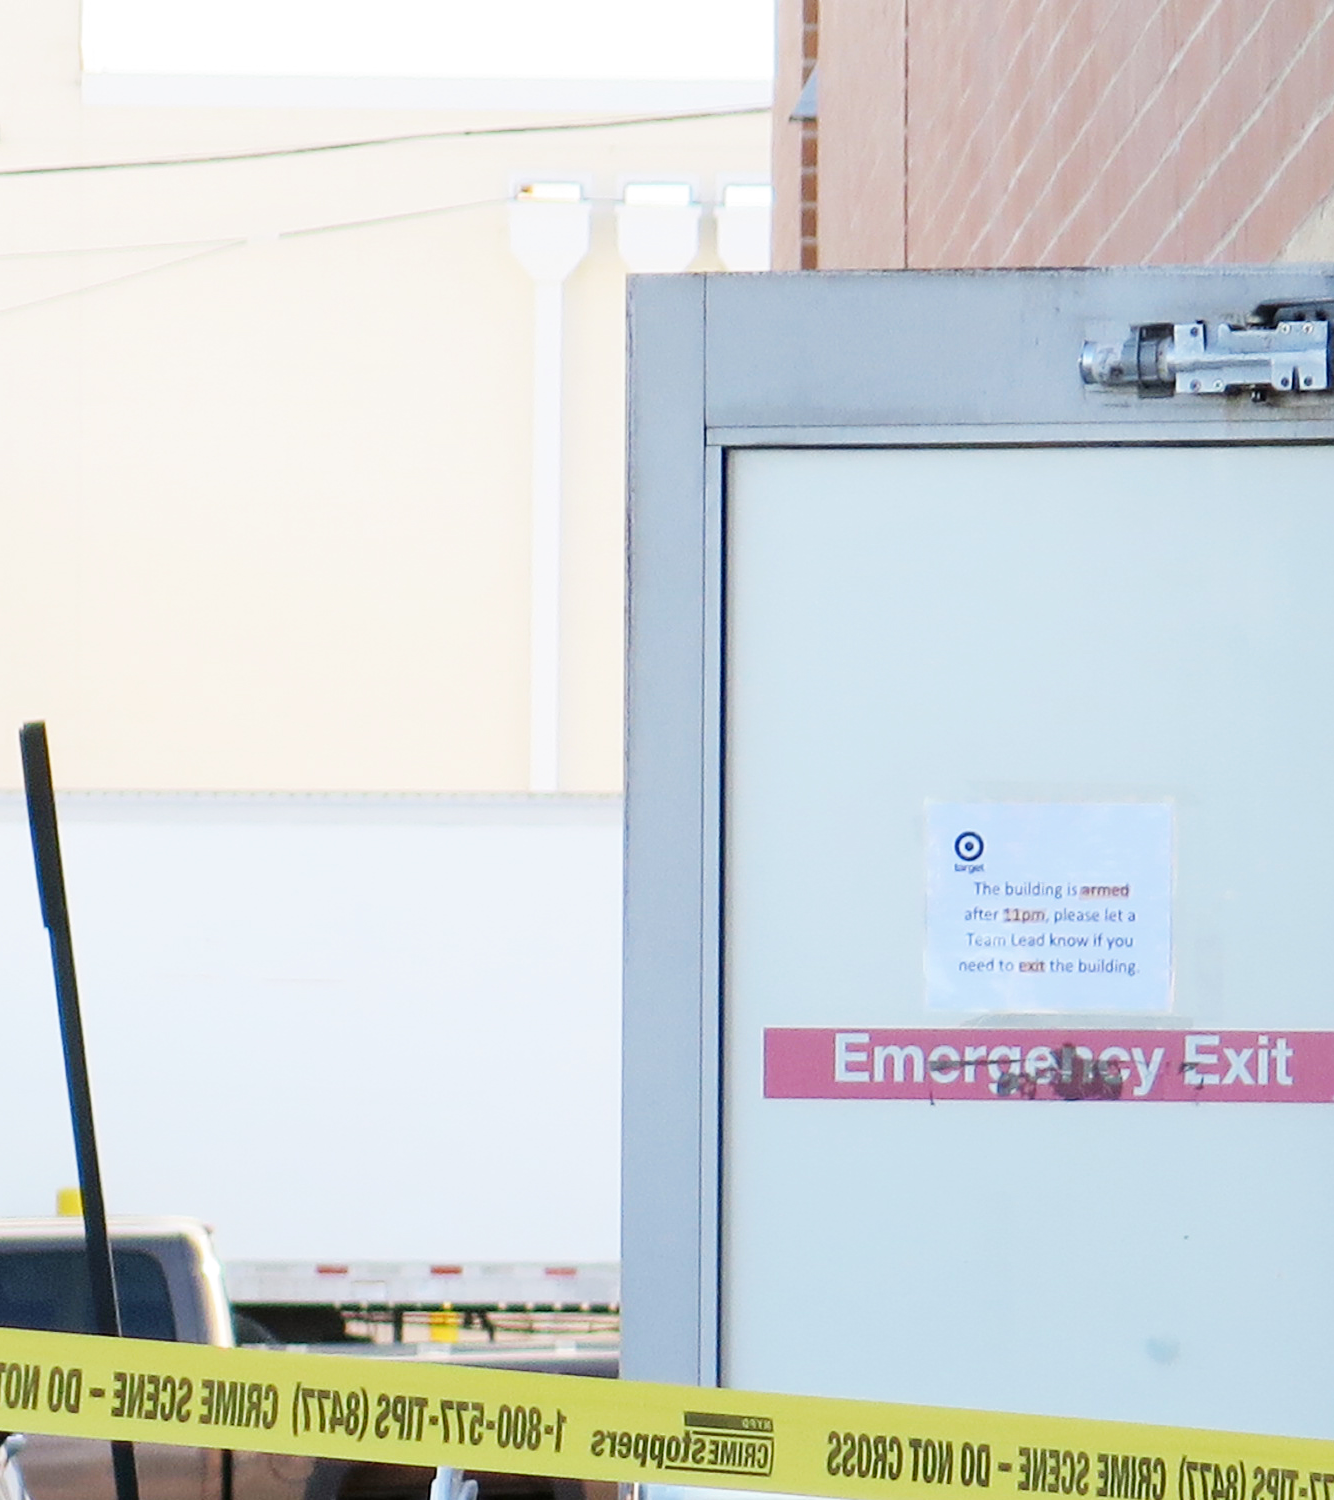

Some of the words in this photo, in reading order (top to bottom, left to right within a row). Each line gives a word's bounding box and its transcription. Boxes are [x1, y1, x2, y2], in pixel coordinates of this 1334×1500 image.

[974, 882, 1000, 896] The
[1005, 882, 1062, 899] building
[1068, 883, 1077, 896] is
[1081, 884, 1130, 897] armed
[965, 909, 998, 921] after
[1003, 908, 1050, 923] 11pm,
[1054, 908, 1100, 923] please
[1105, 908, 1122, 921] let
[1128, 912, 1135, 921] a
[967, 934, 1006, 946] Team
[1011, 933, 1045, 946] Lead
[1049, 933, 1088, 947] know
[1094, 933, 1102, 946] if
[1107, 937, 1134, 949] you
[959, 959, 994, 971] need
[999, 961, 1014, 971] to
[1019, 960, 1045, 972] exit
[1050, 959, 1074, 972] the
[835, 1032, 1165, 1094] Emergency
[1183, 1035, 1295, 1086] Exit
